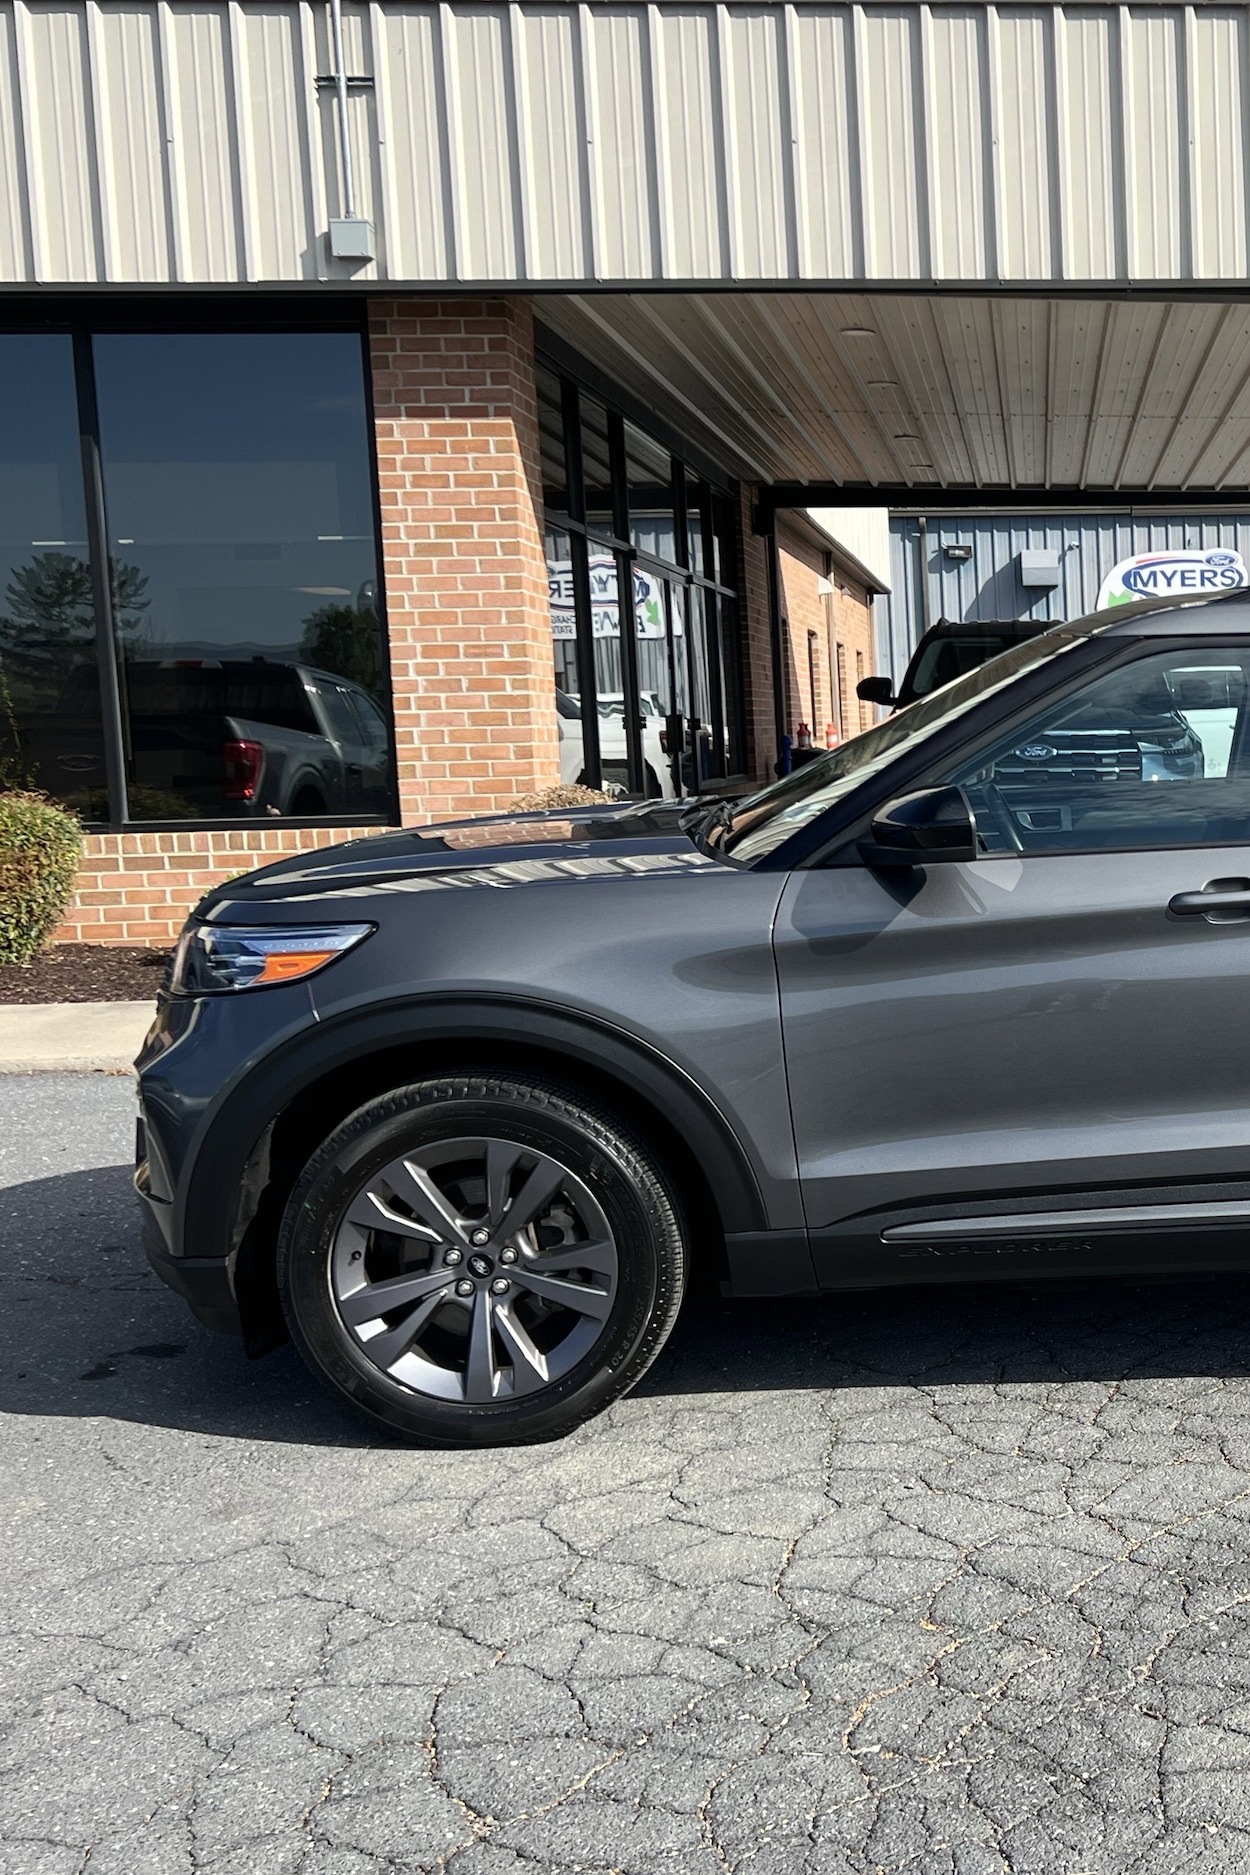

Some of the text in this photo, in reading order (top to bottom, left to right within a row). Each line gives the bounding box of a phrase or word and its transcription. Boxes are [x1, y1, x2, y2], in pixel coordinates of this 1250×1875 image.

[1133, 569, 1236, 588] MYERS
[1024, 746, 1048, 756] Ford
[611, 1297, 645, 1367] 255/55 R 20
